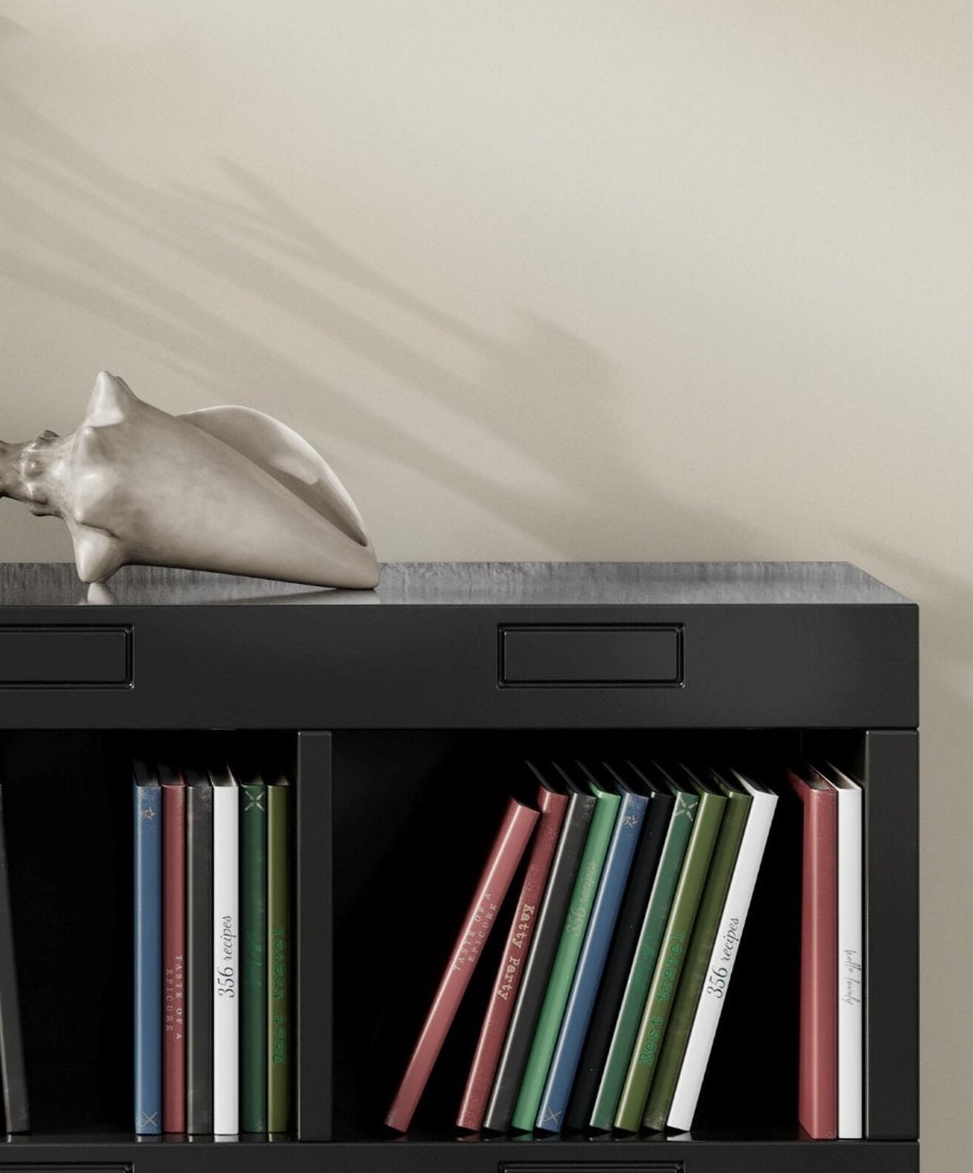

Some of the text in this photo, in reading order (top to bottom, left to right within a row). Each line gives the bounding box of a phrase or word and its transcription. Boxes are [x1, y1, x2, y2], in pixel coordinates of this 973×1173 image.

[217, 915, 237, 998] 356 recipes
[453, 929, 476, 971] TASTE
[475, 907, 485, 922] OF
[468, 903, 497, 962] EPICURE
[498, 904, 535, 1001] Katty Party
[707, 917, 739, 999] 356 recipes
[166, 969, 174, 1032] EPICURE
[175, 955, 183, 1040] TASTE OF A
[639, 1016, 663, 1066] Best
[656, 932, 685, 1002] travel
